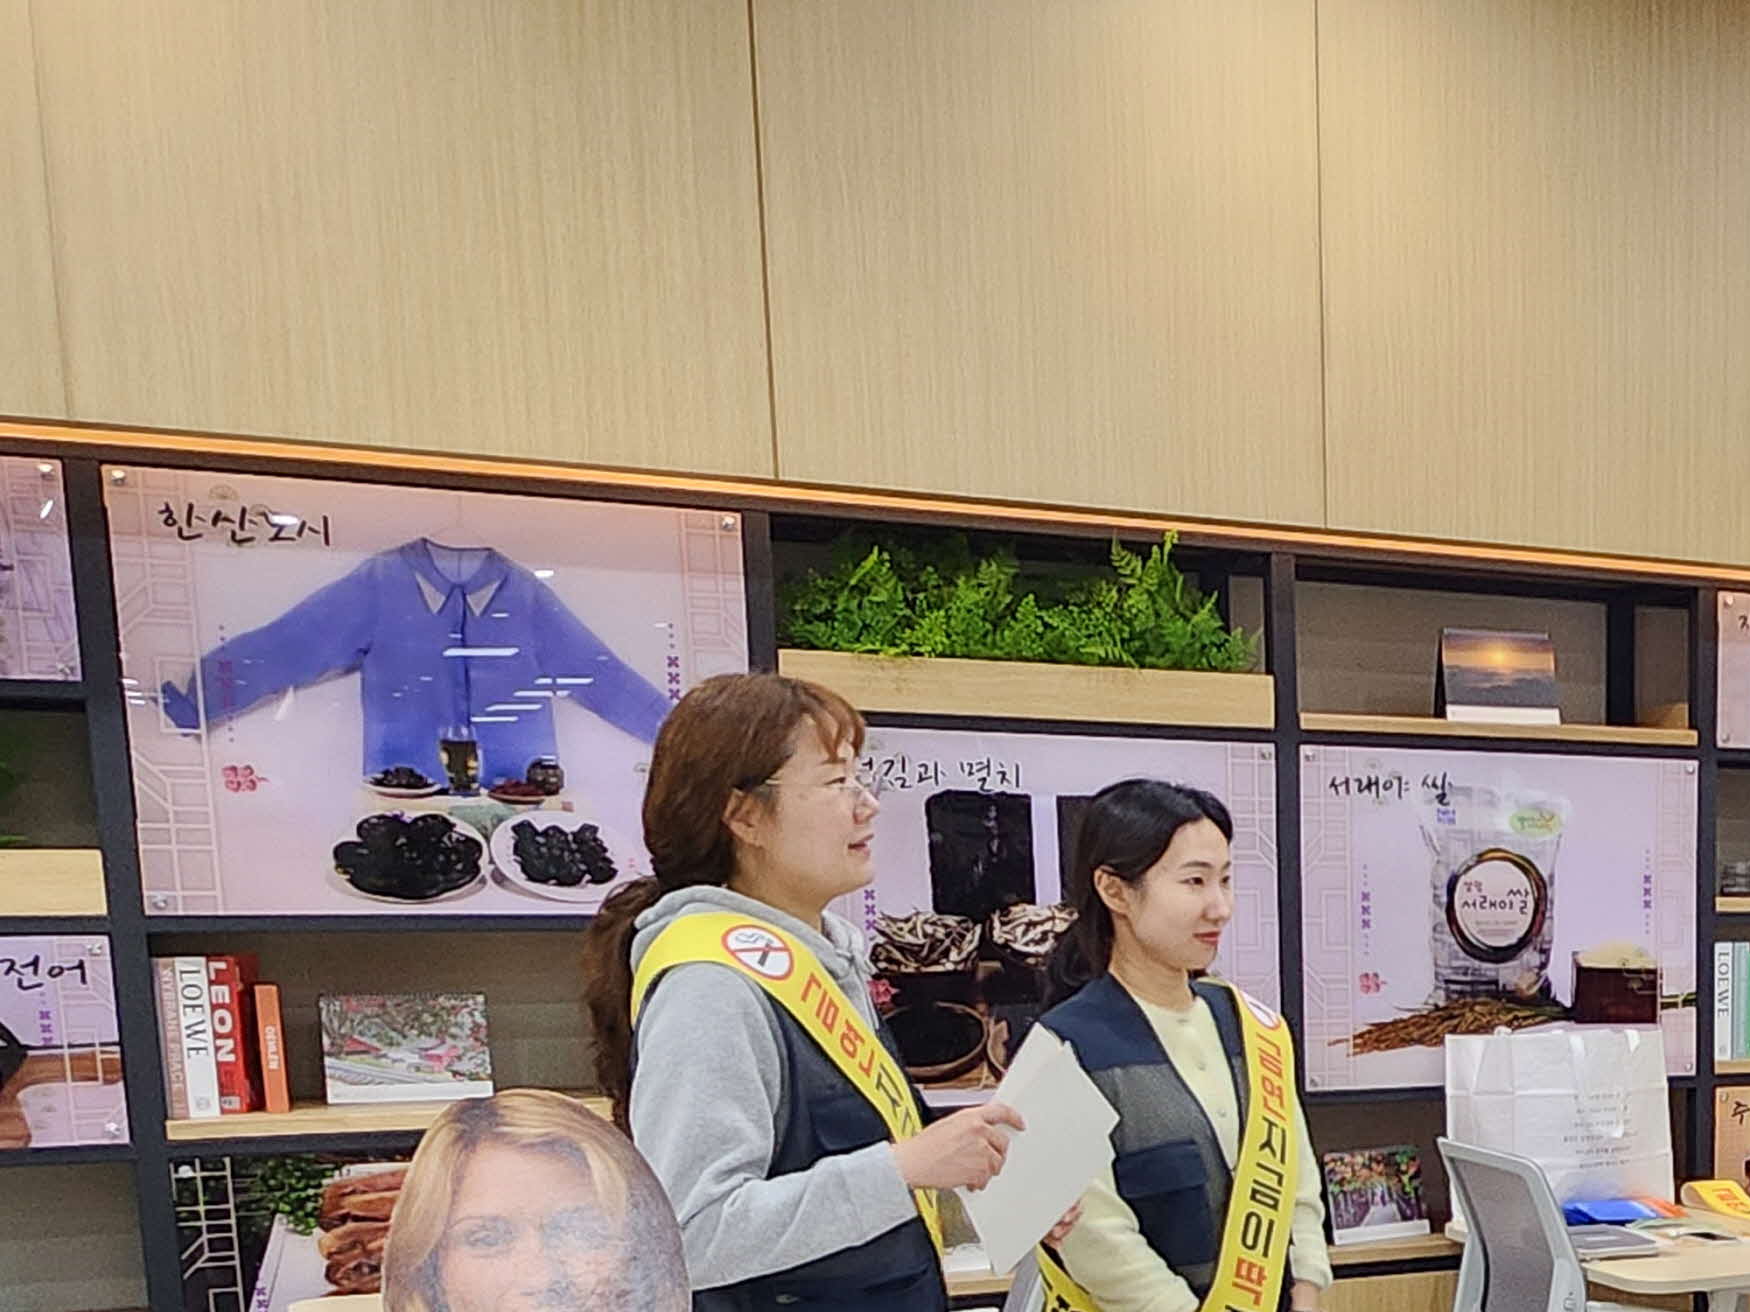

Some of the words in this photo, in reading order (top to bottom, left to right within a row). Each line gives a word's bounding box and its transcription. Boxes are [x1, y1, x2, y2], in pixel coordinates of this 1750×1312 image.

[960, 757, 1021, 793] 멸치
[0, 954, 88, 991] 전어
[1717, 951, 1731, 1019] LOEWE
[179, 968, 210, 1059] LOEWE
[207, 960, 237, 1063] LEON
